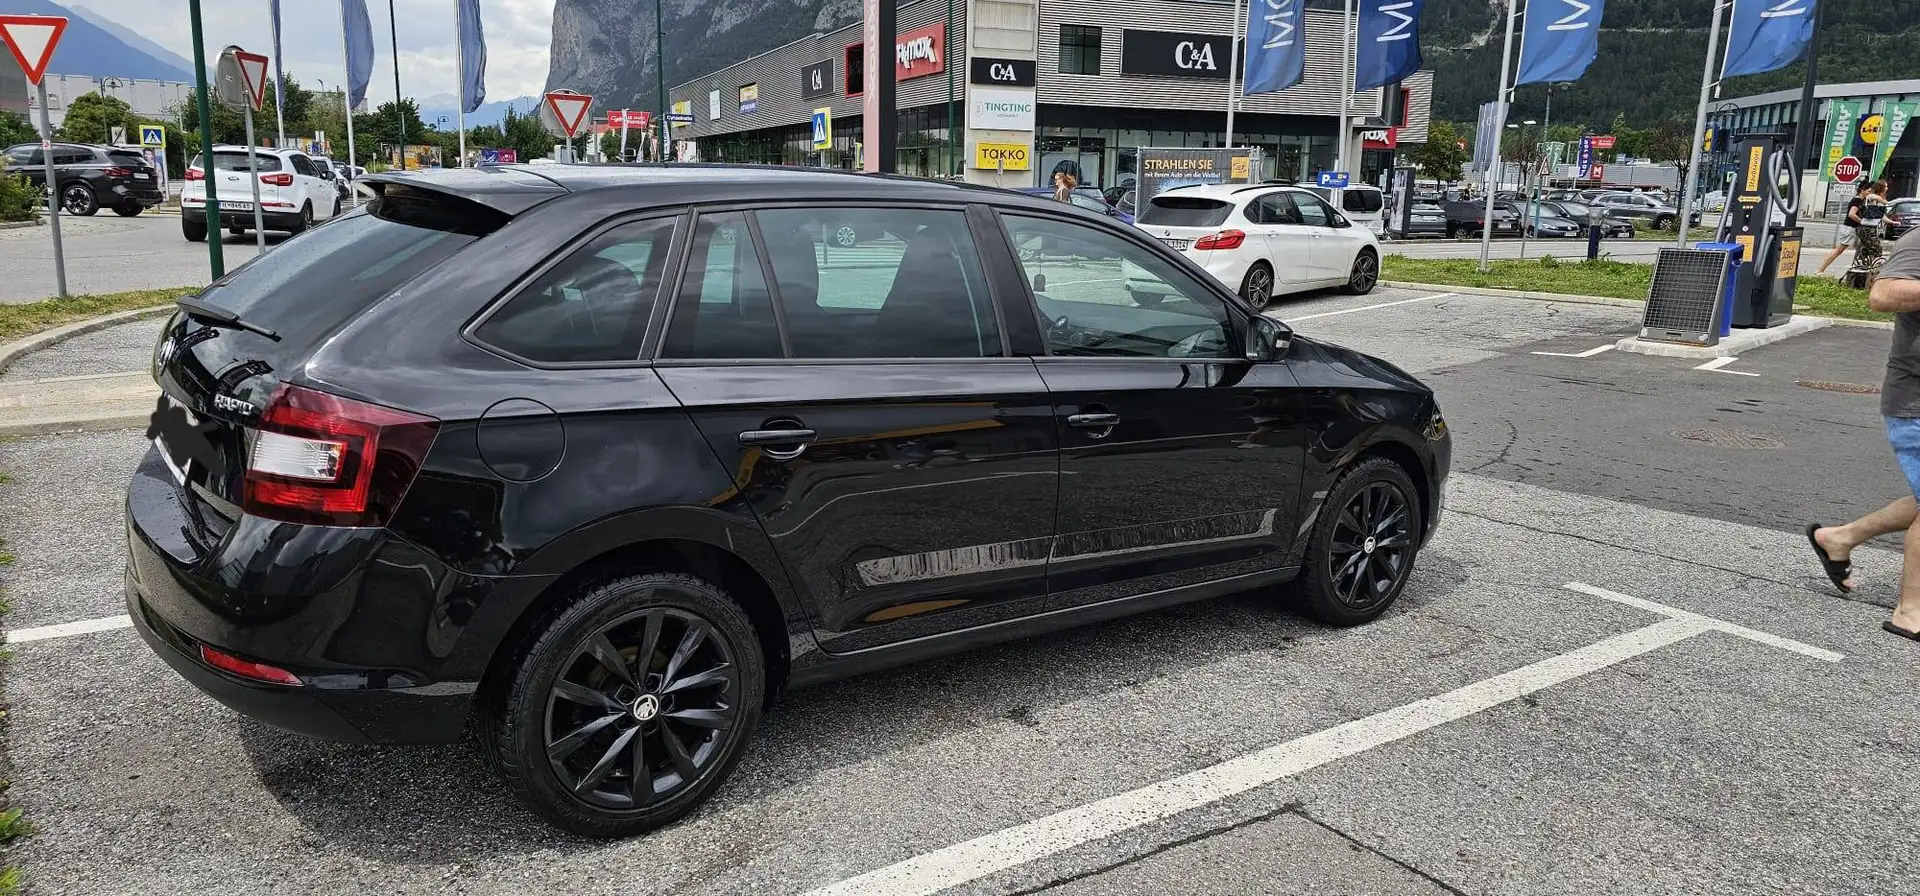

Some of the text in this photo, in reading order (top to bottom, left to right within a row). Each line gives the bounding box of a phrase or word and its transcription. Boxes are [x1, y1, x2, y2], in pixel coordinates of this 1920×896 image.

[1175, 41, 1216, 70] C&A
[990, 63, 1016, 81] C&A
[985, 102, 1031, 113] TINGTING
[1144, 159, 1213, 170] STRAHLEN SIE
[1837, 164, 1859, 175] STOP
[214, 393, 255, 416] RAPID
